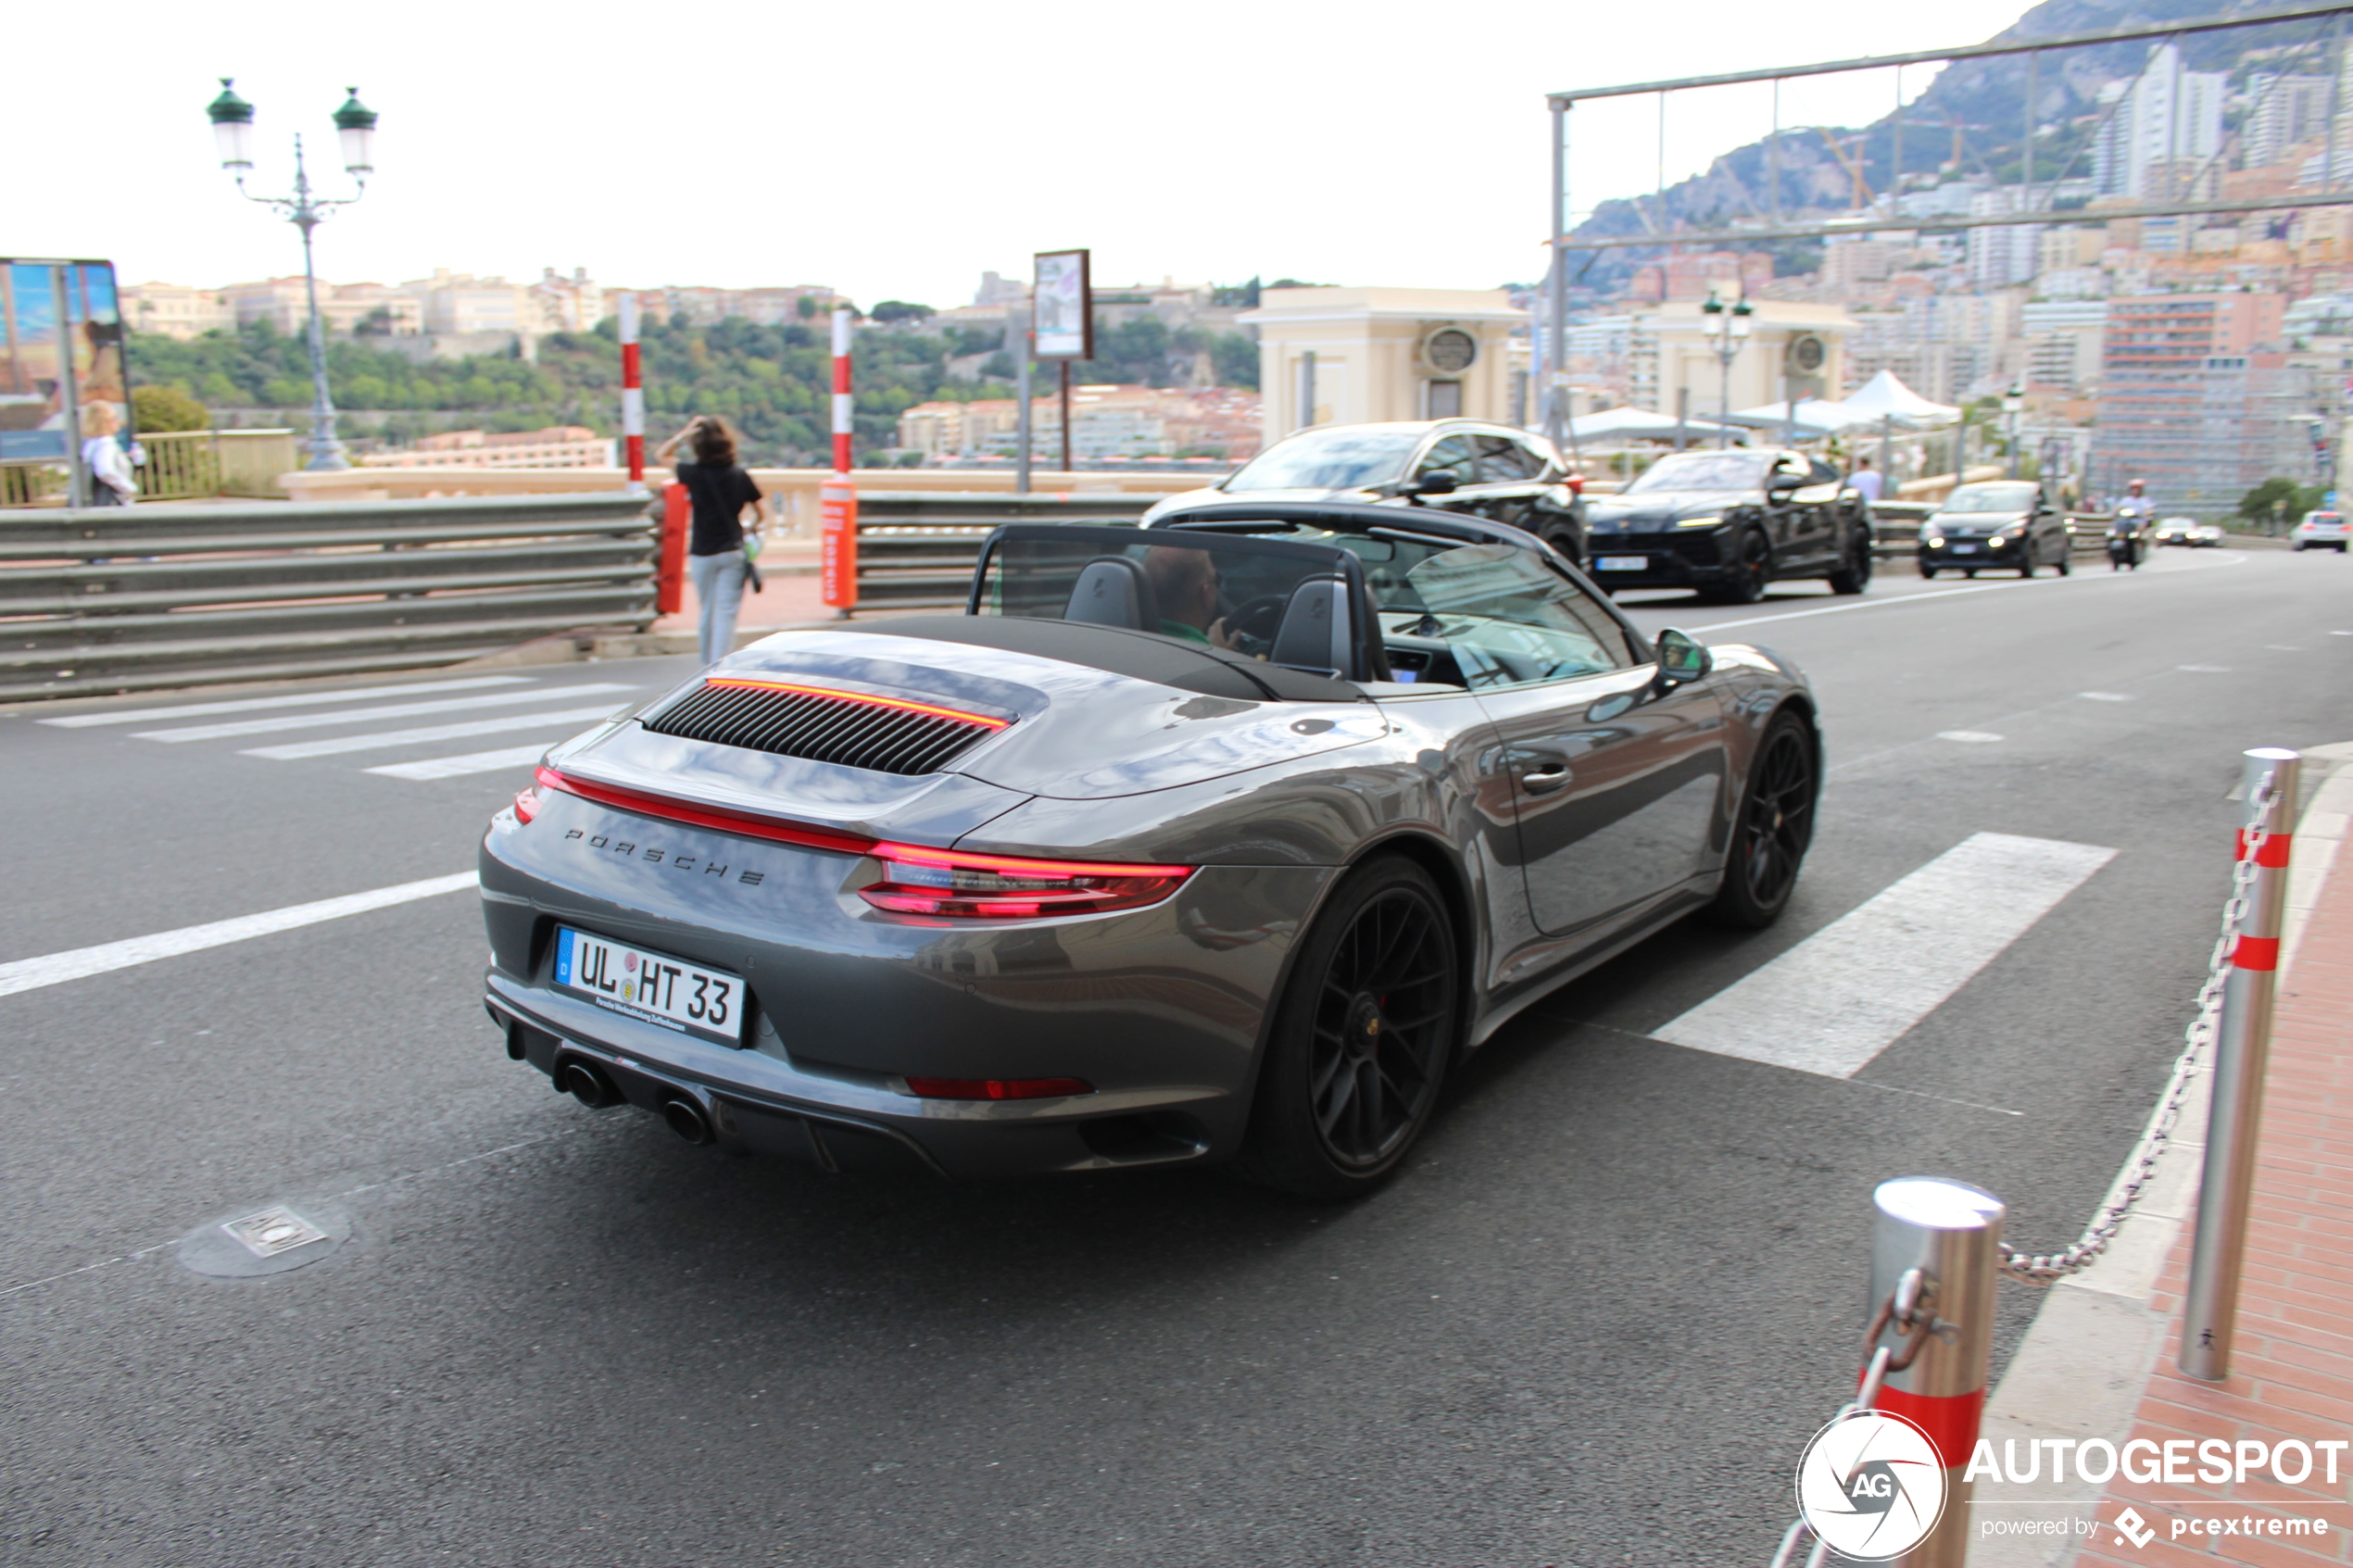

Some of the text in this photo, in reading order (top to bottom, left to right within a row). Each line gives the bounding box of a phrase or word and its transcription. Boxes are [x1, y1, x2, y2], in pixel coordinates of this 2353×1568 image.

[564, 829, 764, 885] PORSCHE
[560, 962, 568, 976] D
[581, 942, 730, 1026] UL HT 33
[596, 997, 614, 1010] Porsche
[650, 1013, 686, 1032] Zuffenhausen
